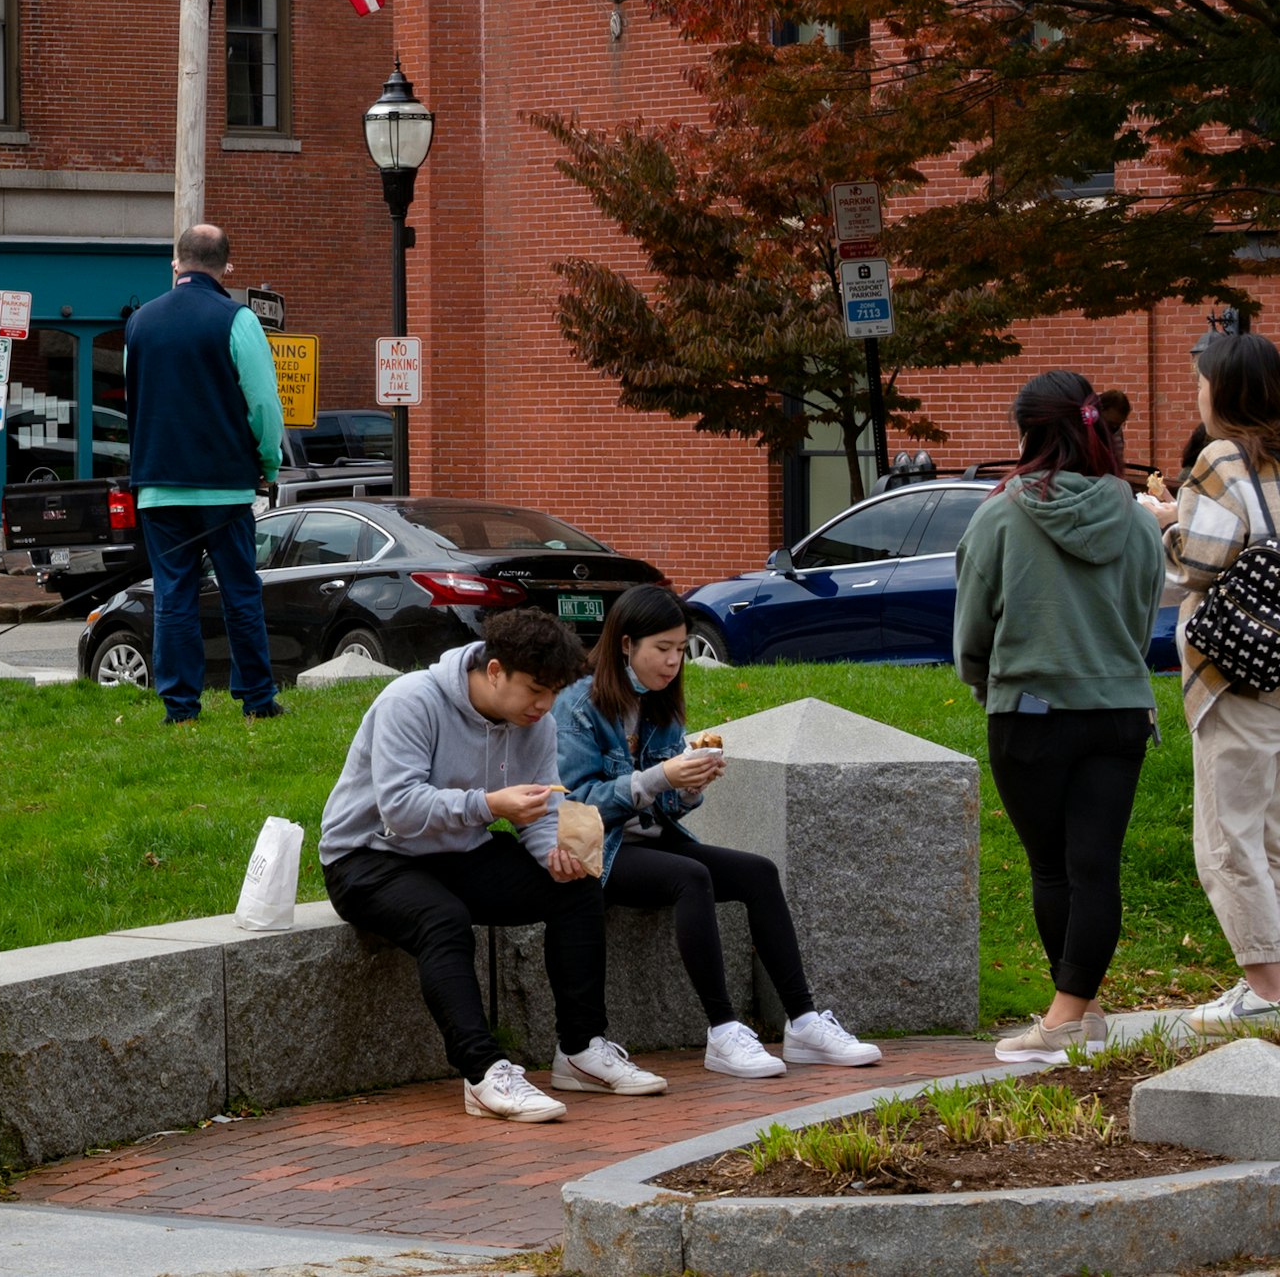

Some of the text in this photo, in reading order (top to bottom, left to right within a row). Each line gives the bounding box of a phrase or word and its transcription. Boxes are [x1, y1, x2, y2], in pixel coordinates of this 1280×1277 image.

[849, 187, 863, 196] NO
[839, 197, 875, 206] PARKING
[849, 284, 883, 292] PASSPORT
[851, 291, 882, 299] PARKING
[2, 300, 29, 308] PARKING
[252, 300, 267, 315] ONE
[856, 309, 881, 319] 7113
[271, 344, 307, 359] NING
[391, 344, 407, 356] NO
[380, 359, 418, 371] PARKING
[276, 373, 311, 383] IPMENT
[391, 372, 408, 381] ANY
[389, 381, 409, 391] TIME
[43, 510, 67, 520] GMC
[562, 601, 601, 615] HKT 391
